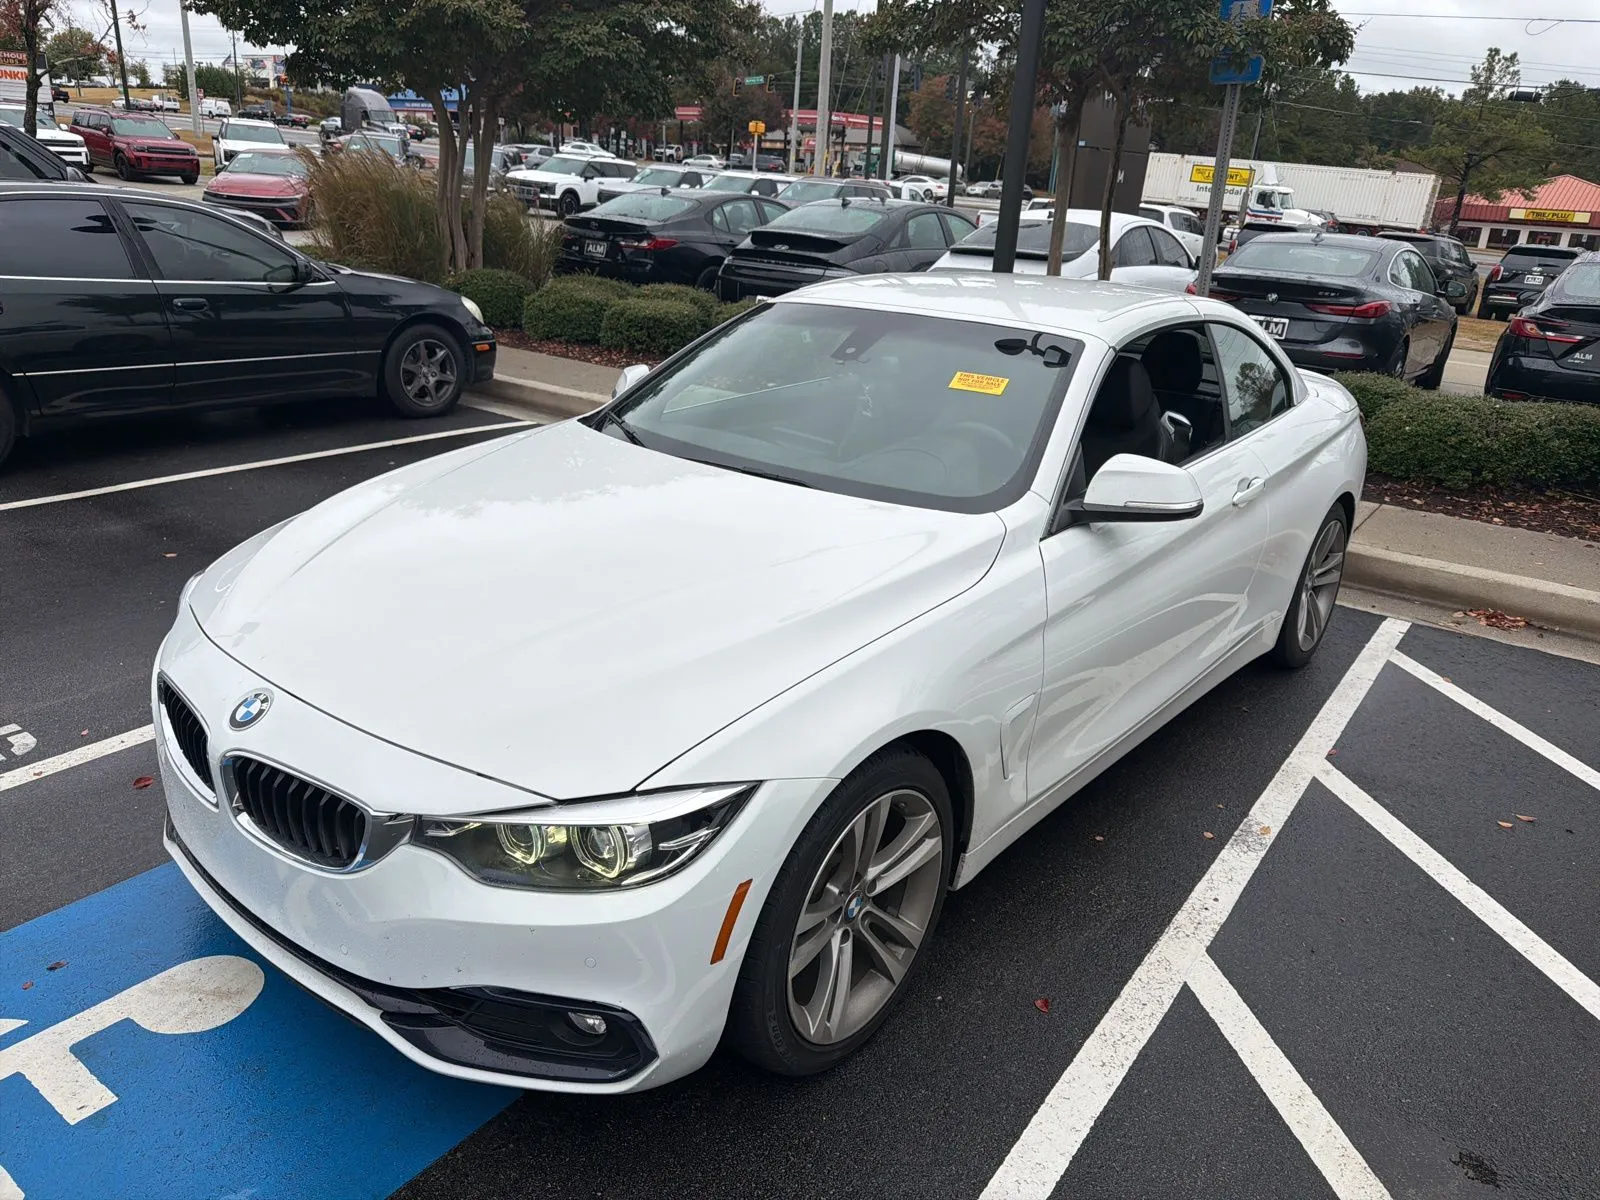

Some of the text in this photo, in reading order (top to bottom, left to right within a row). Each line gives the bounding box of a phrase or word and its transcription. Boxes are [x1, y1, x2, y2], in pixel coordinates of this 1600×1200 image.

[1196, 184, 1243, 196] Inteodal
[587, 244, 604, 253] ALM
[1258, 320, 1284, 335] LM
[1573, 352, 1593, 361] ALM
[976, 375, 1005, 384] VEHICLE
